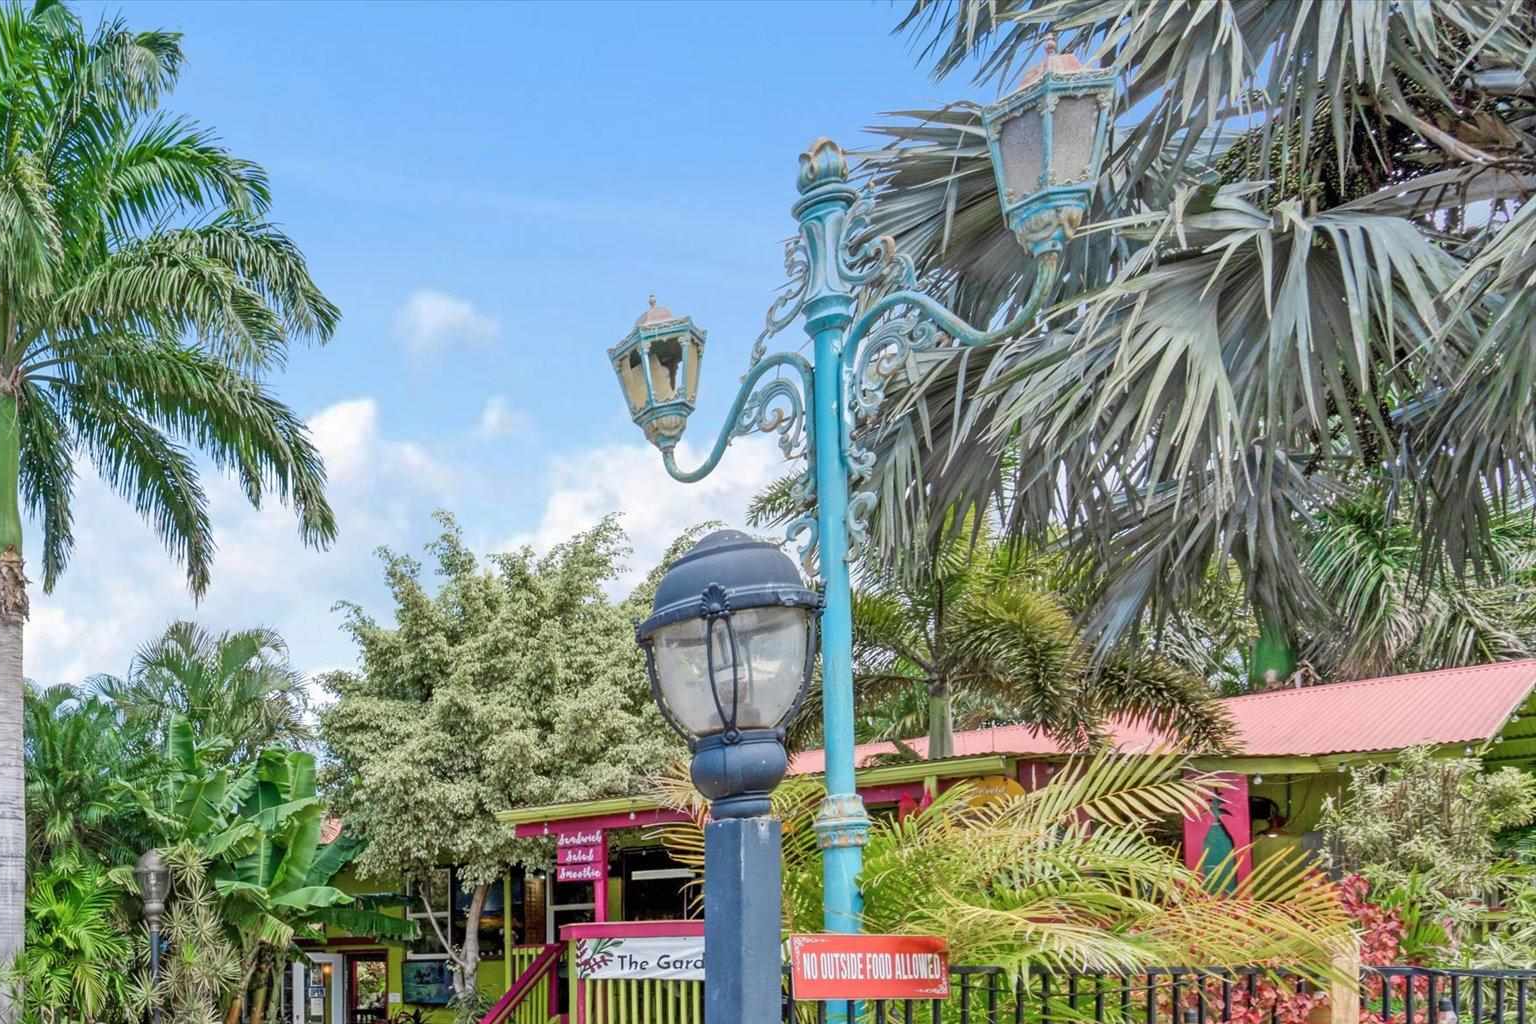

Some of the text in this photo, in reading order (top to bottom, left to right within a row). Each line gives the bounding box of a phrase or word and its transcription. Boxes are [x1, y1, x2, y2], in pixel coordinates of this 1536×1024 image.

[617, 952, 705, 971] The Gard
[802, 952, 941, 980] NO OUTSIDE FOOD ALLOWED
